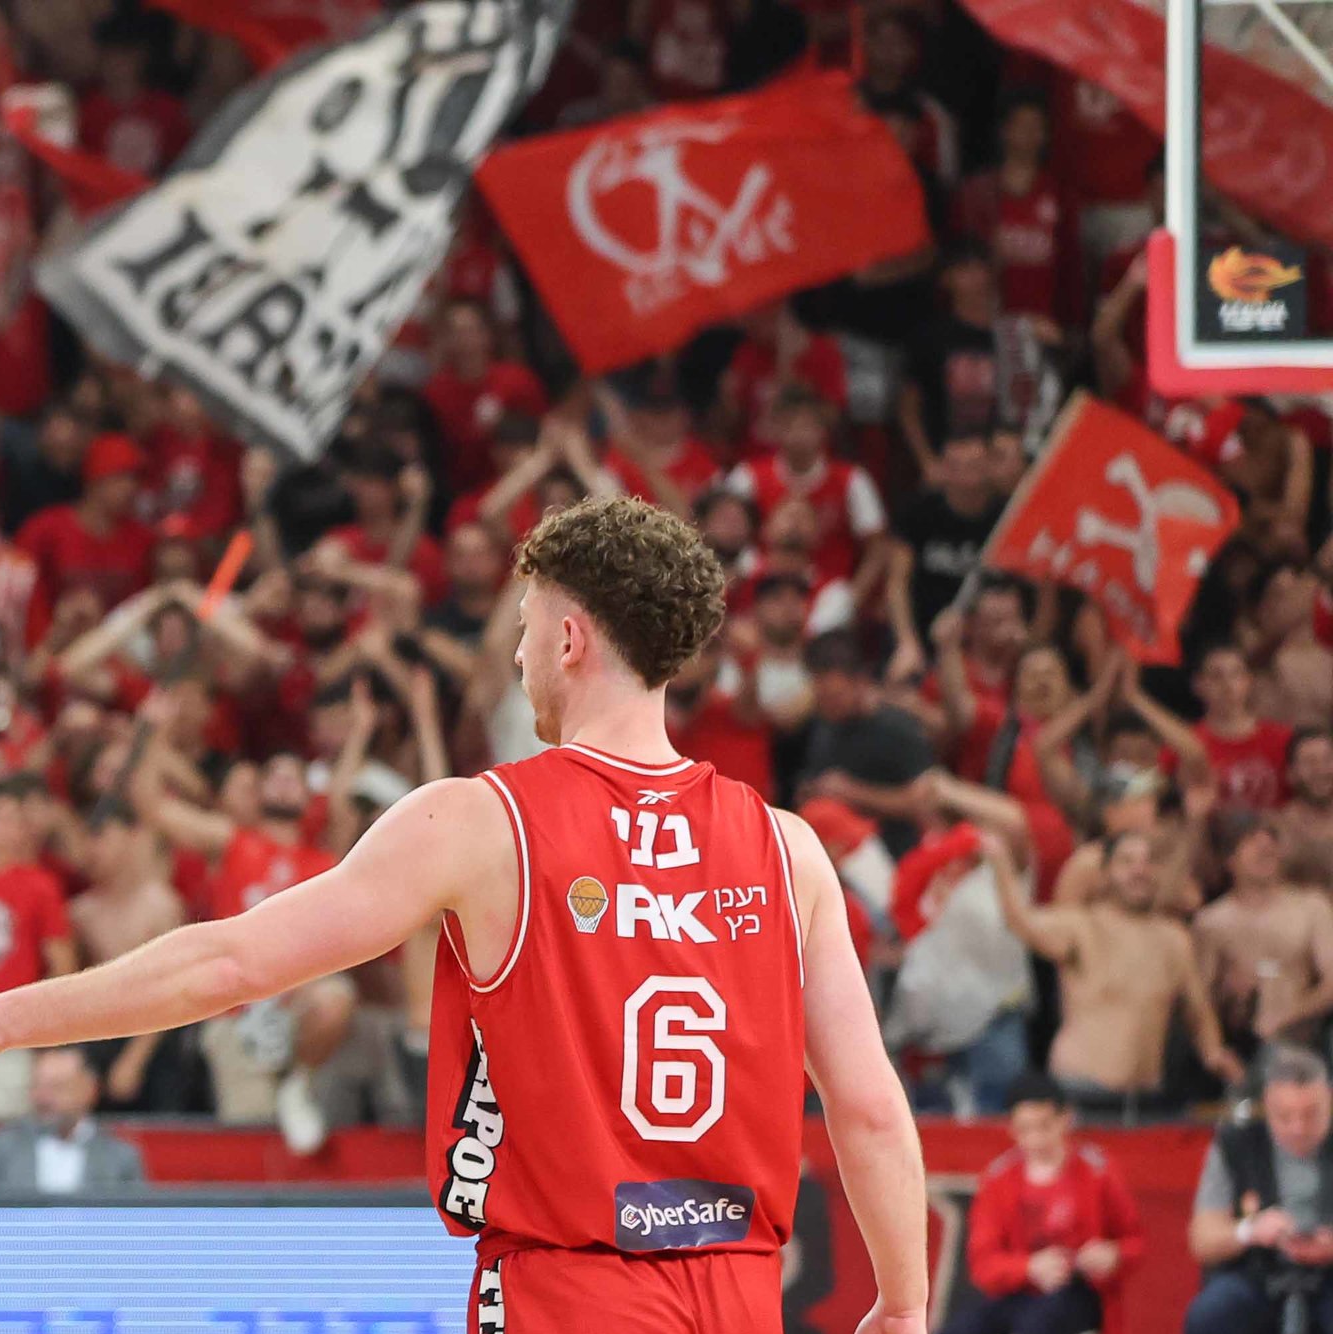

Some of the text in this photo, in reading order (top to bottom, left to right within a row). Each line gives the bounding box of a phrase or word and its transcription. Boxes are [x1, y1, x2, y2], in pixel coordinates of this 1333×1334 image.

[611, 806, 700, 870] בני
[616, 884, 718, 943] RK
[714, 886, 767, 914] רענן
[725, 914, 760, 941] כץ
[620, 975, 726, 1143] 6
[621, 1198, 745, 1236] CyberSafe
